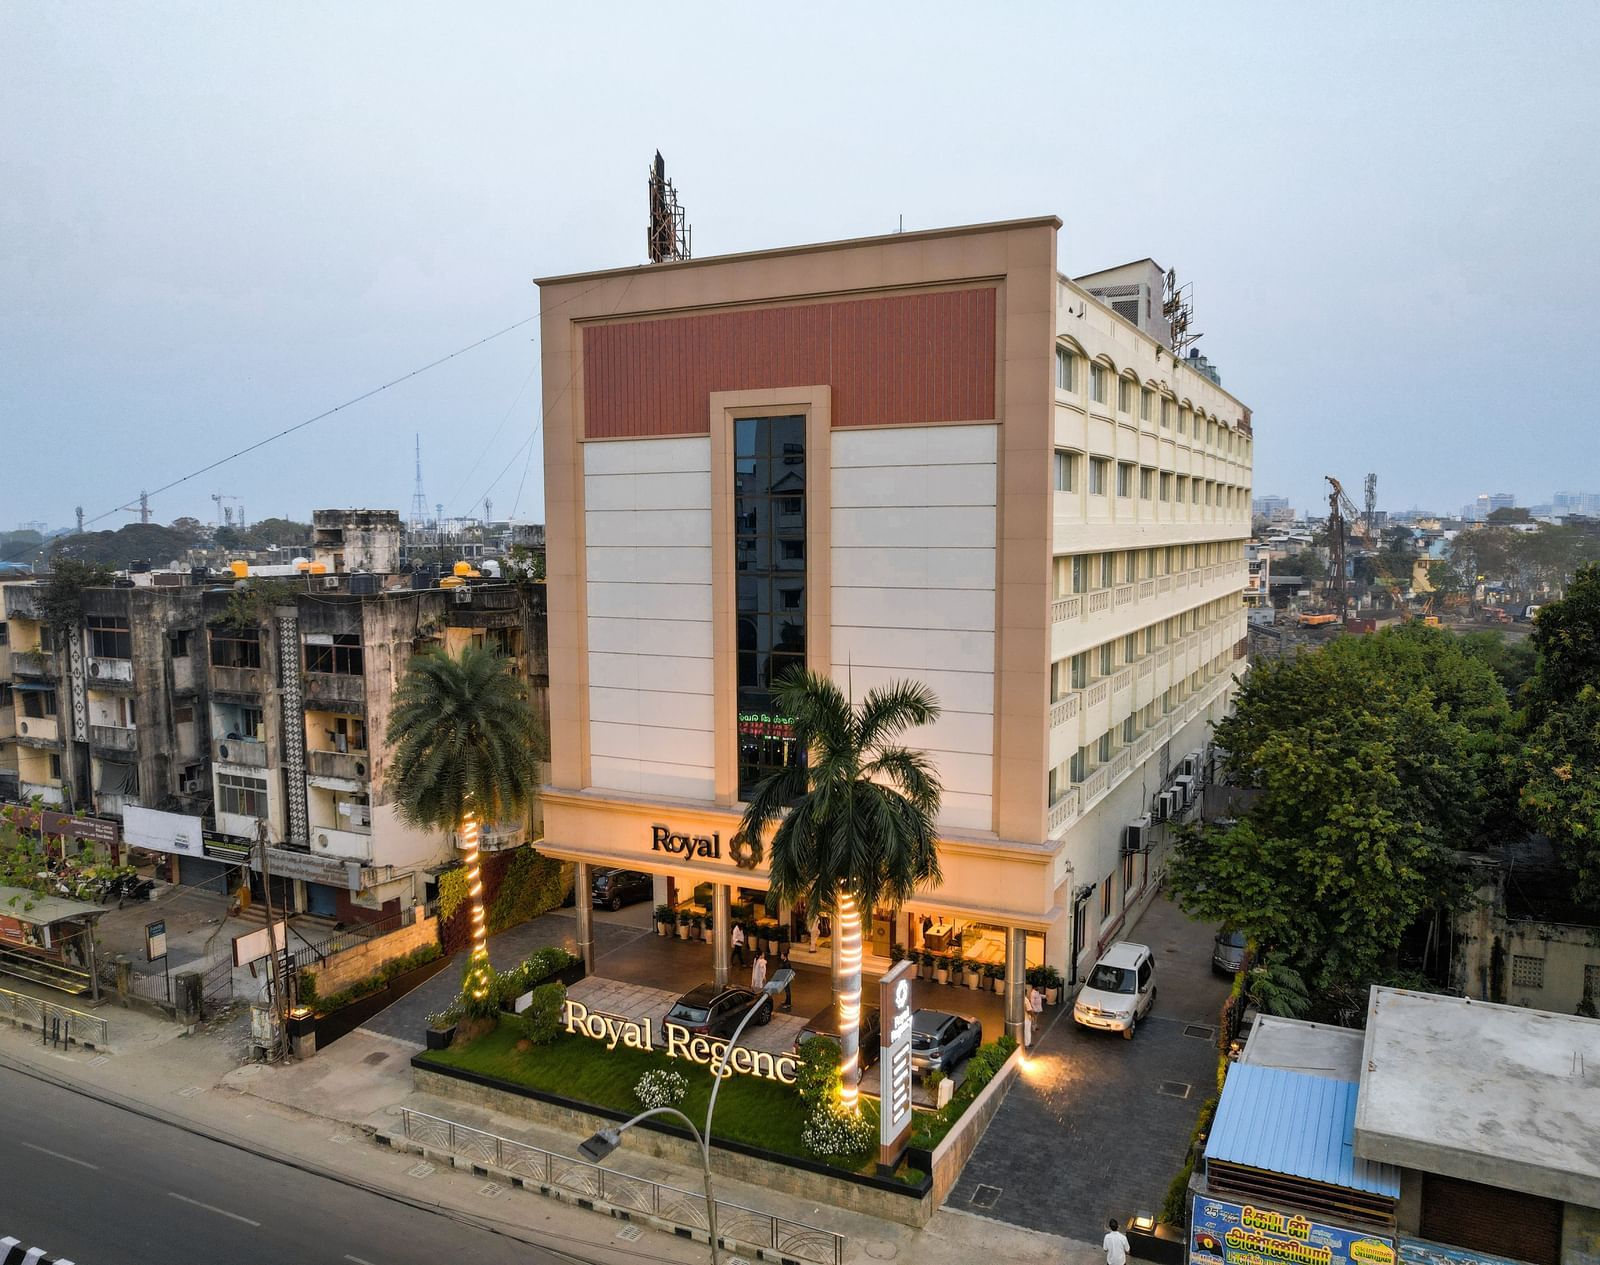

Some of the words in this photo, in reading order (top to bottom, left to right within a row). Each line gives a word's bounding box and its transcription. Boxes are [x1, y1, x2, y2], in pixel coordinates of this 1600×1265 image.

[651, 822, 721, 861] Royal
[565, 1000, 654, 1051] Royal
[665, 1022, 805, 1085] Regenc
